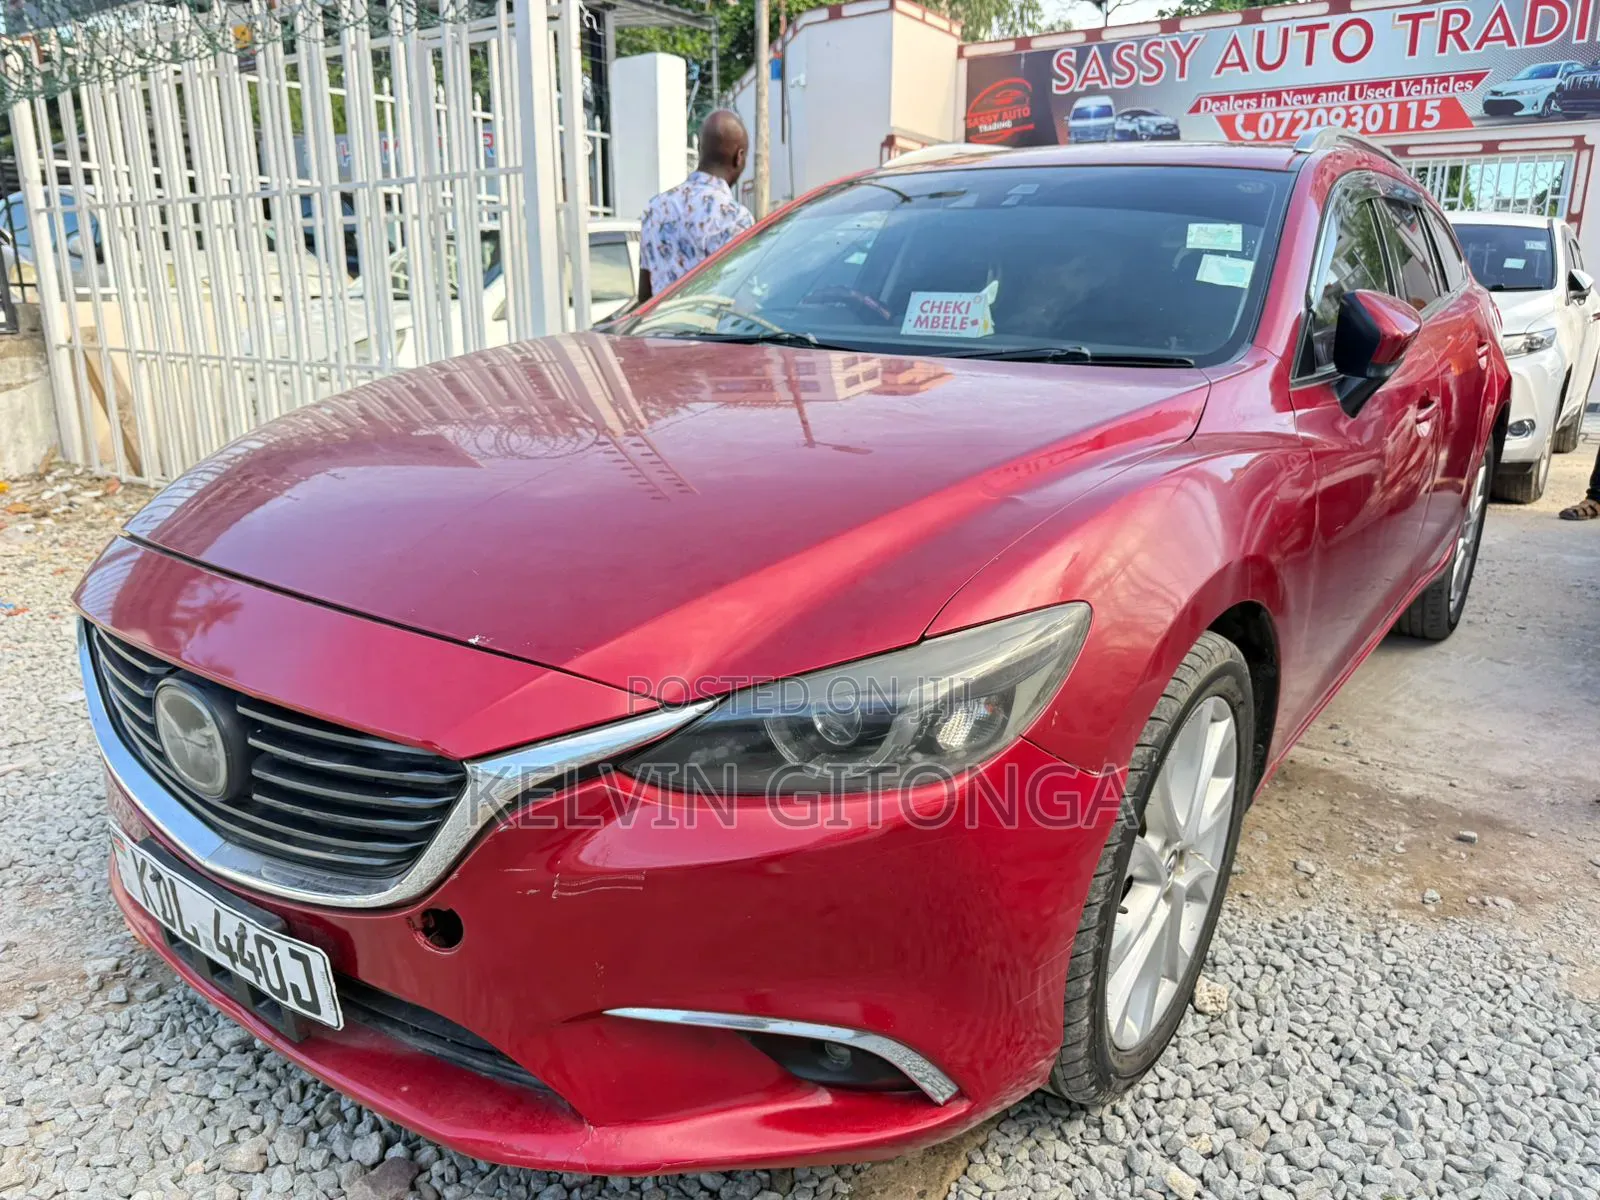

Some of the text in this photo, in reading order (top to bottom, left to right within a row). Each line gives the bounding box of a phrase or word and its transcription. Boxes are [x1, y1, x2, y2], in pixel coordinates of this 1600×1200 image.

[1052, 0, 1600, 94] SASSY AUTO TRADI
[1200, 76, 1473, 113] Dealers in New and Used Vehicles
[1002, 106, 1031, 121] AUTO
[1257, 99, 1442, 140] 0720930115
[913, 315, 969, 330] MBELE
[920, 299, 971, 315] CHEKI
[130, 848, 201, 947] KDL
[213, 907, 322, 1016] 440J
